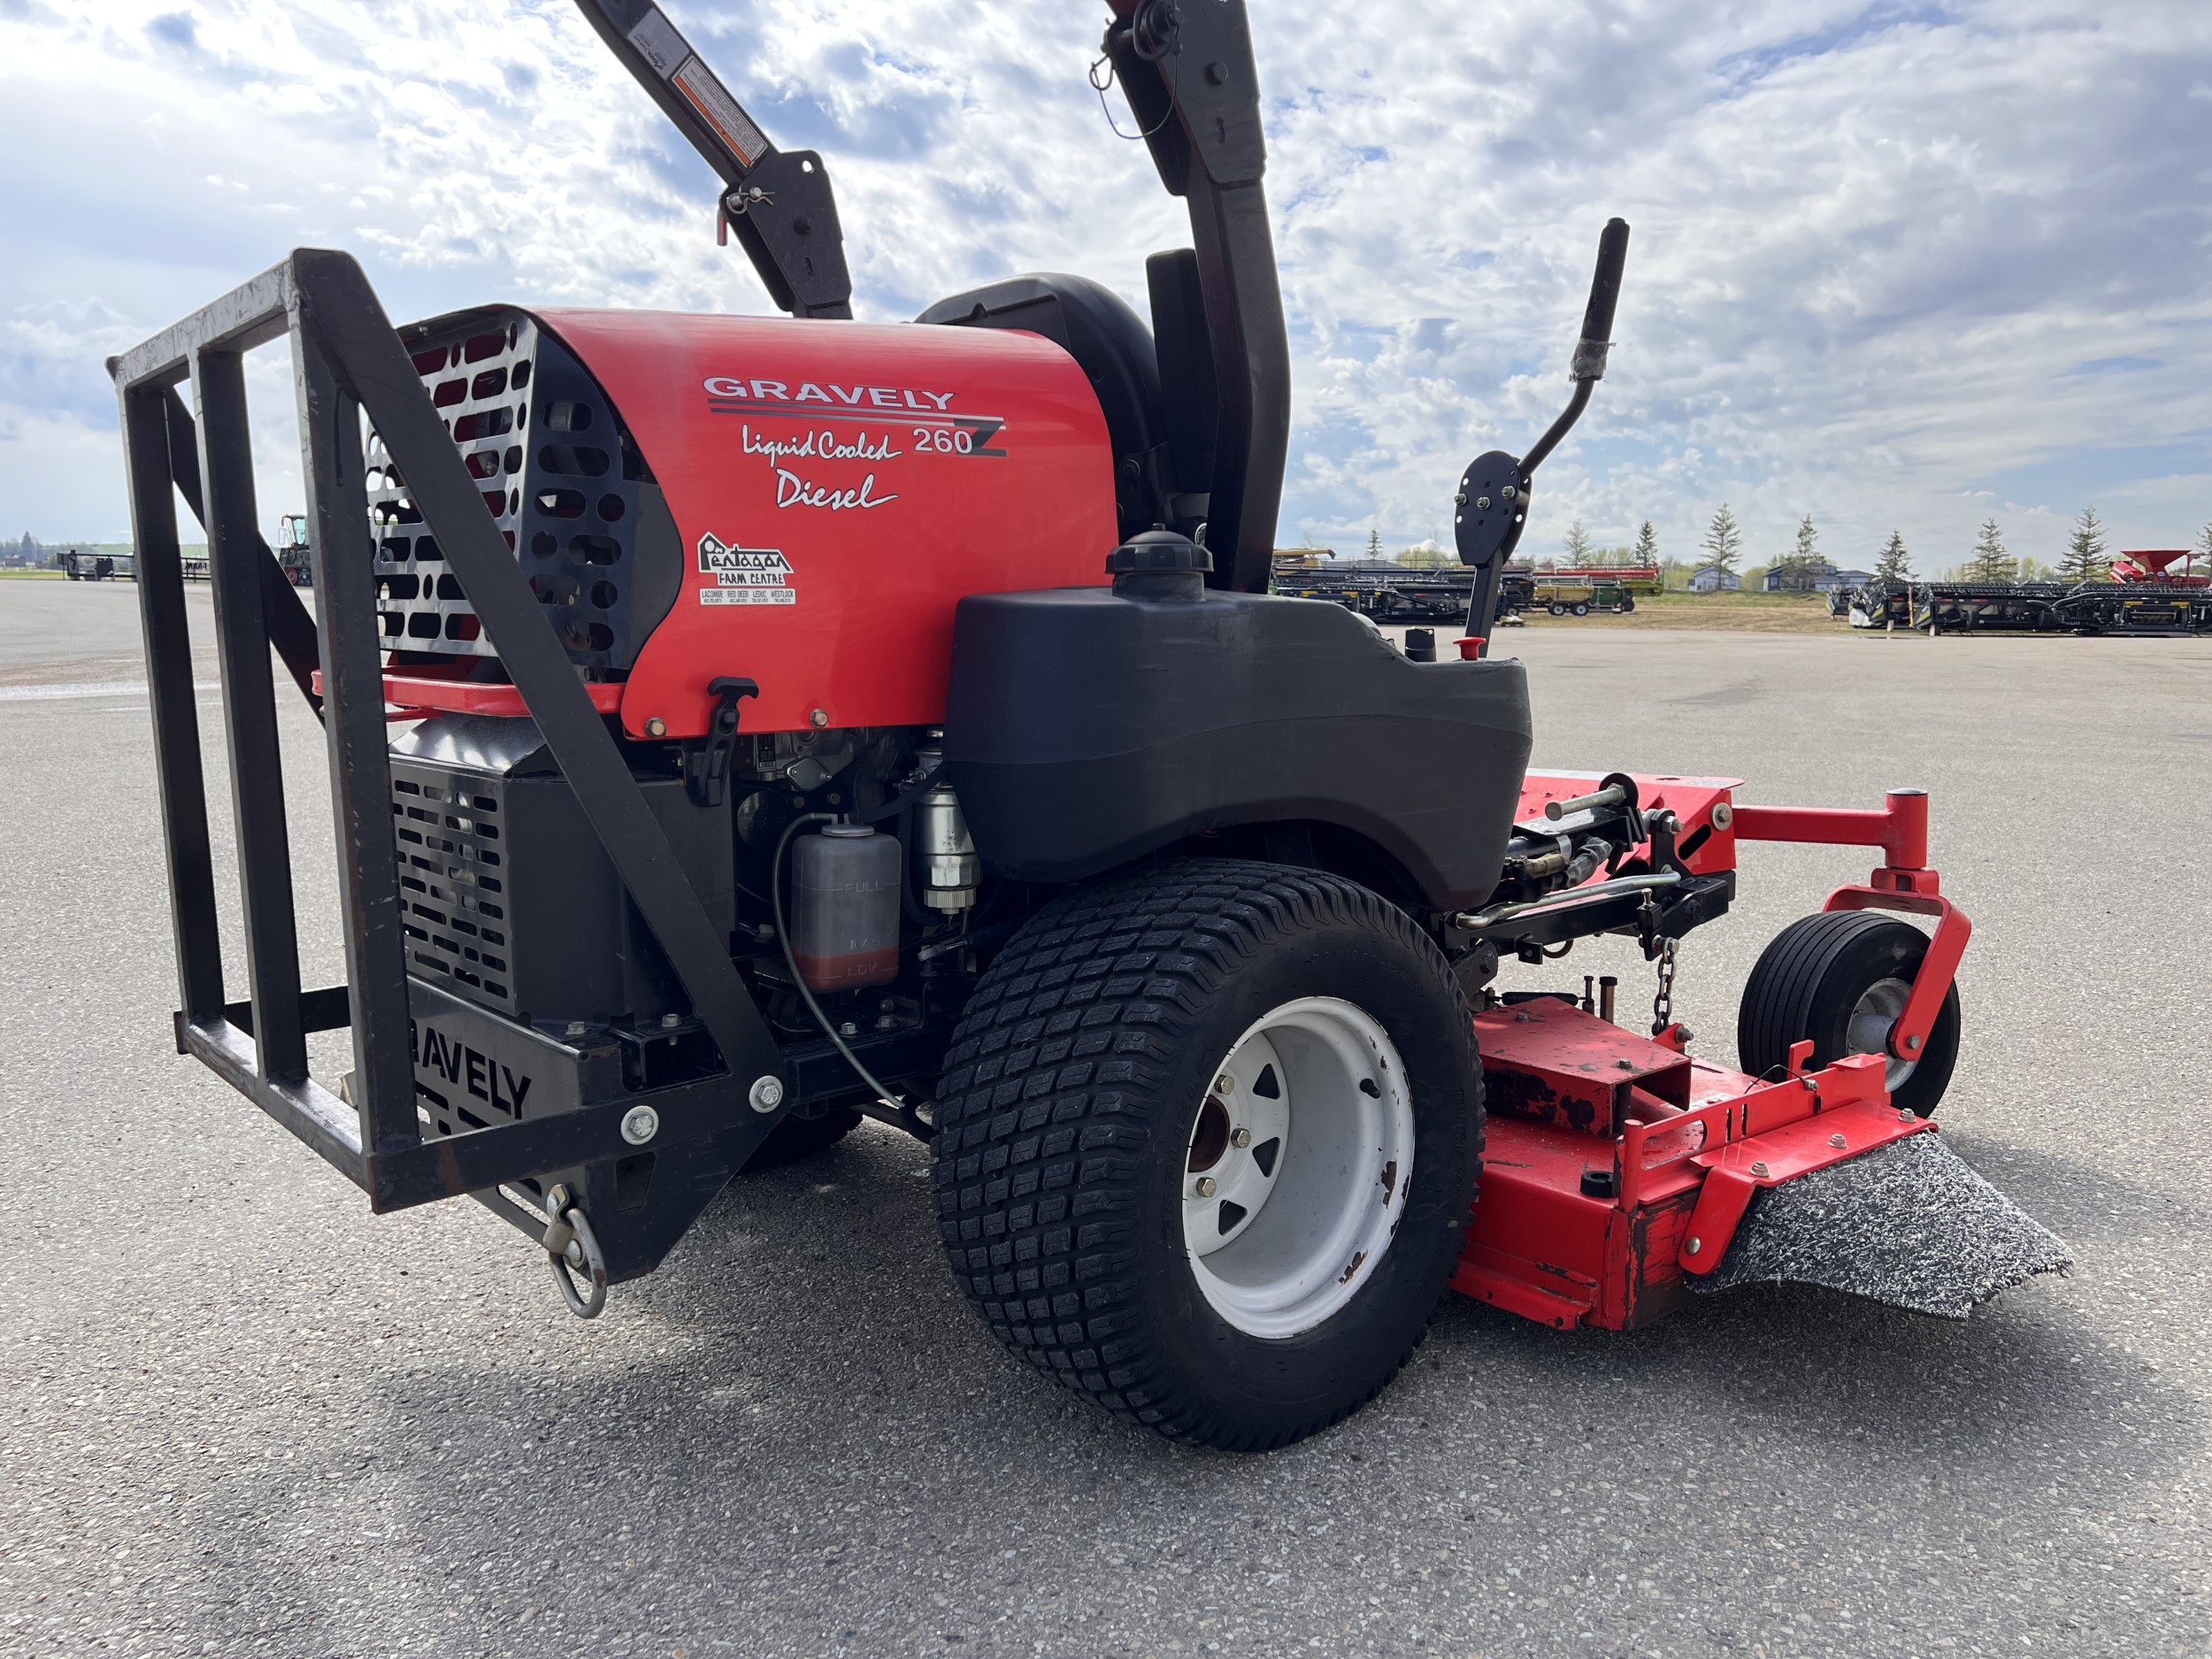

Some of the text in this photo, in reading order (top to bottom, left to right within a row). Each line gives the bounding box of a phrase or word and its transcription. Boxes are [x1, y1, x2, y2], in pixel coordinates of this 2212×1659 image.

[703, 377, 956, 411] GRAVELY
[741, 424, 902, 467] Liquid Cooled
[775, 468, 899, 511] Diesel
[700, 534, 791, 572] Pentagon
[719, 572, 784, 585] FARM CENTRE
[844, 880, 885, 895] FULL
[848, 963, 878, 977] LOW
